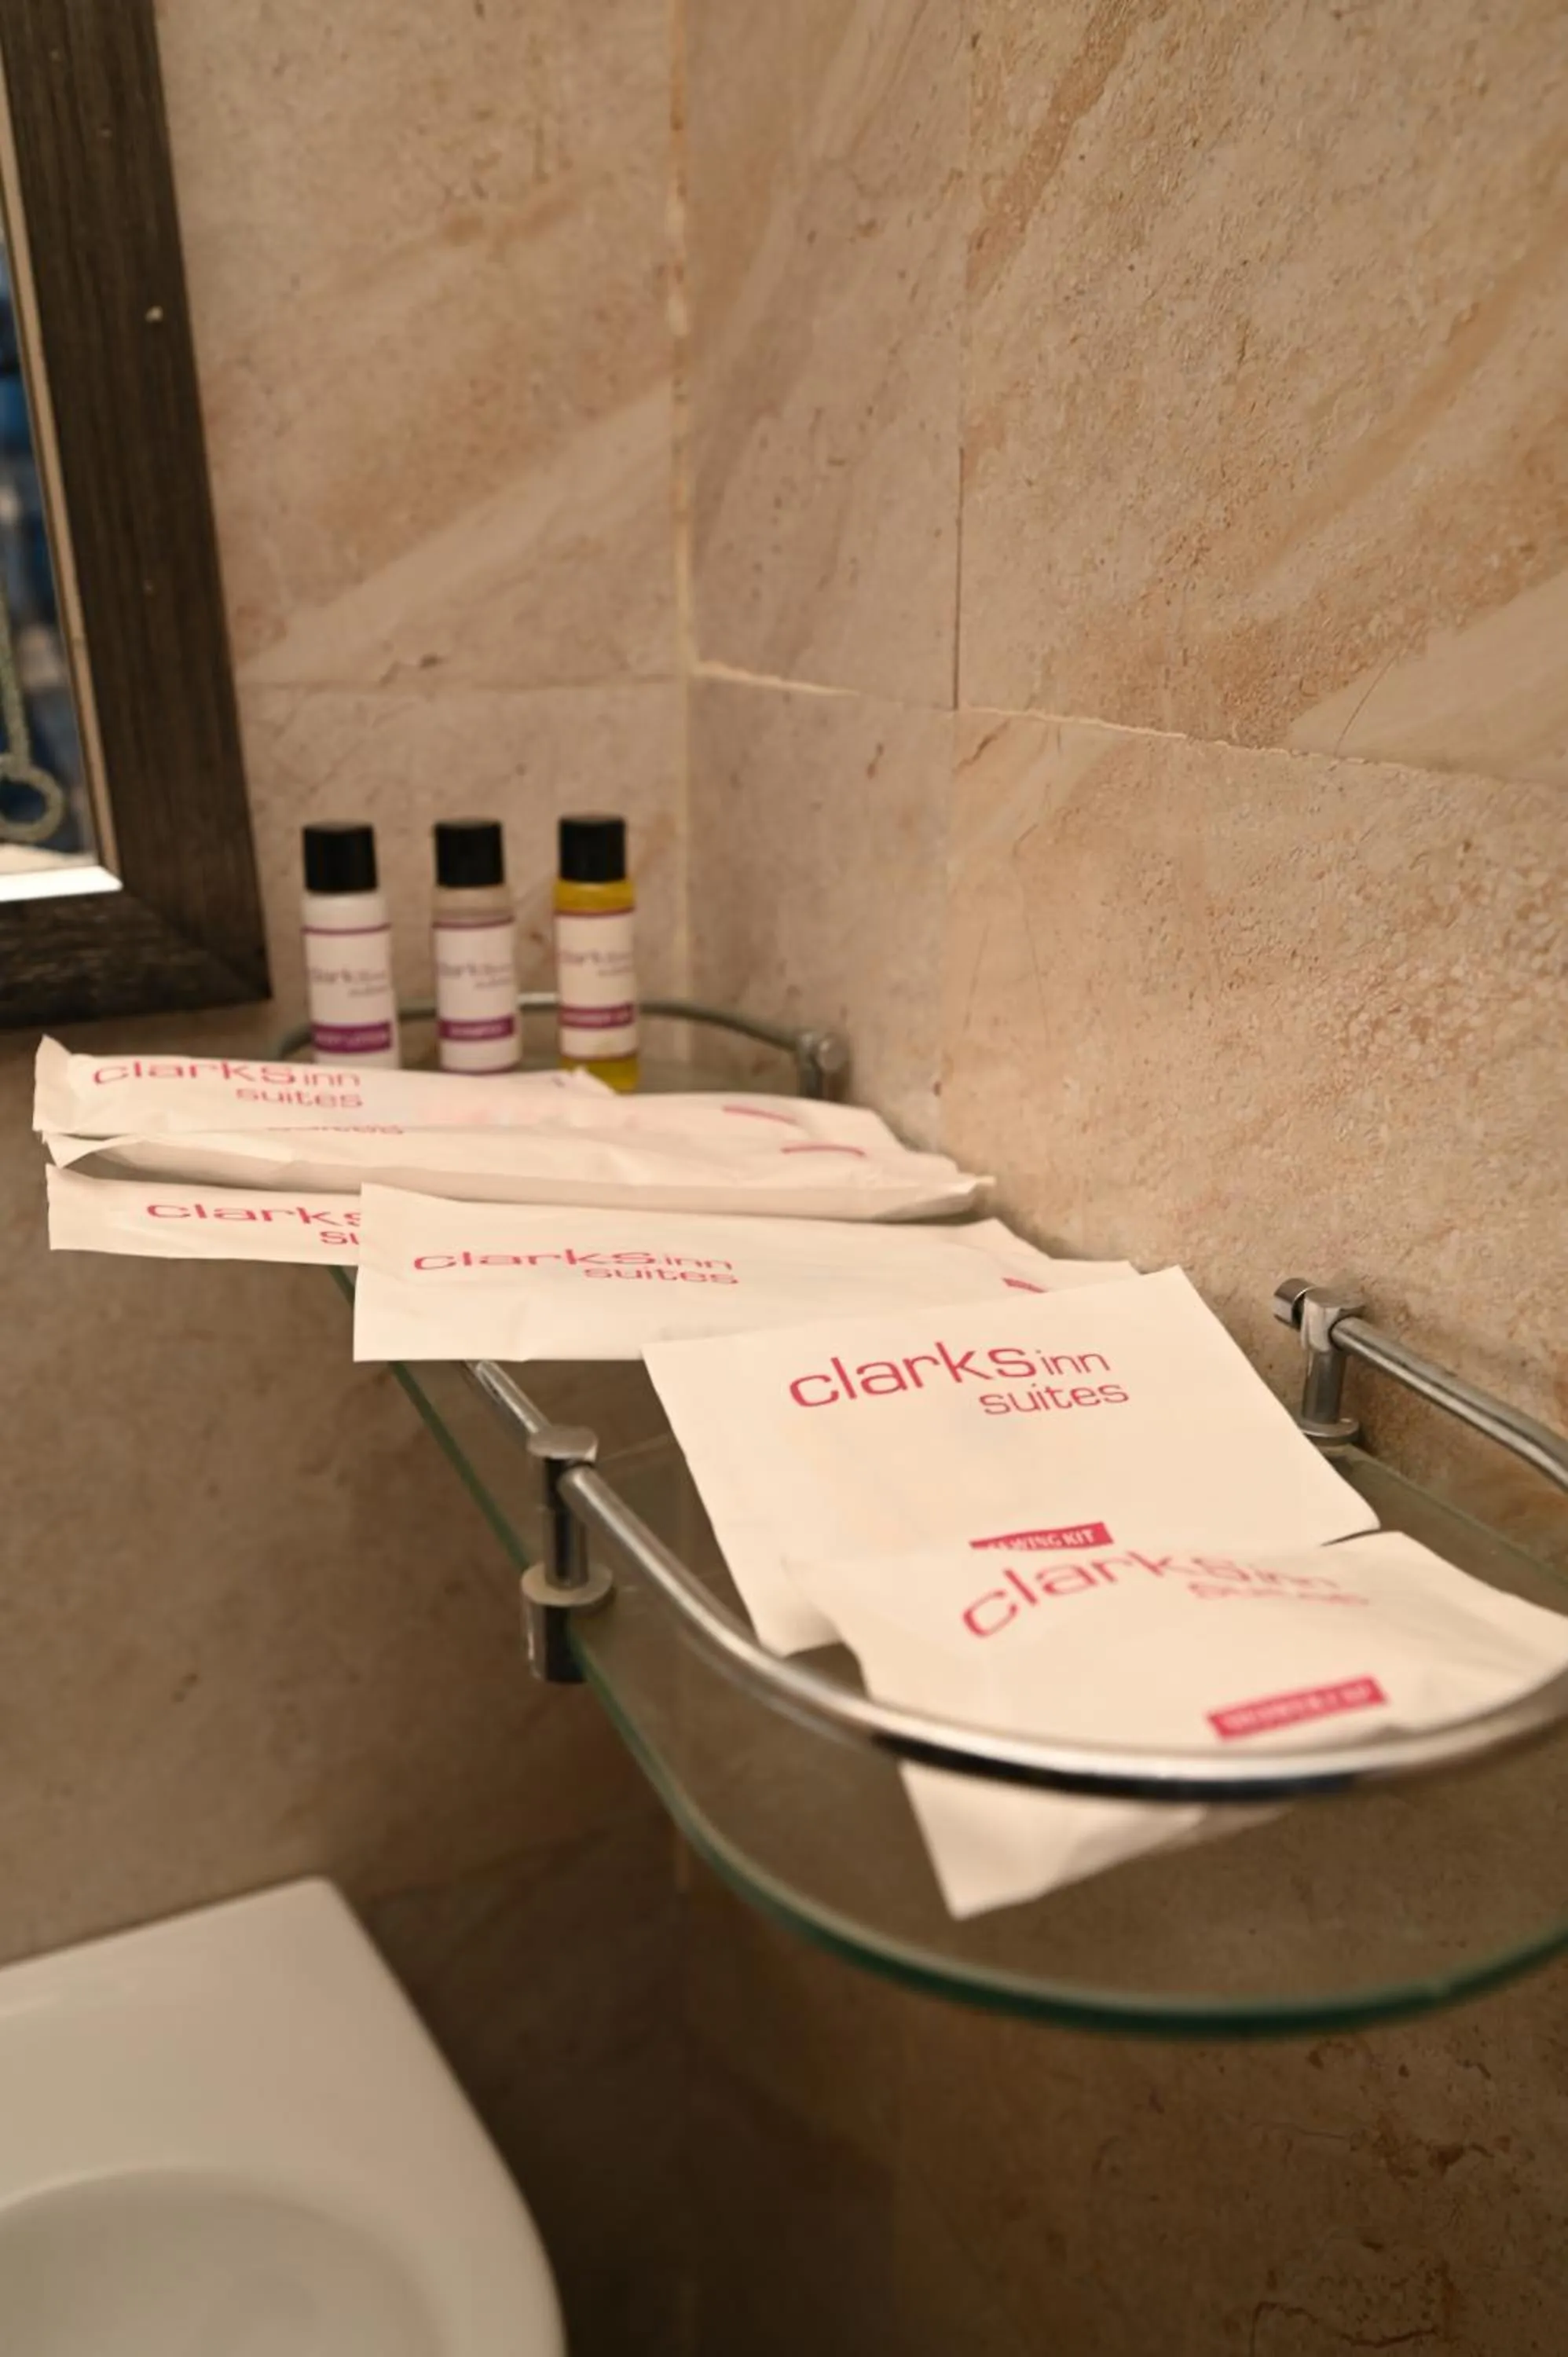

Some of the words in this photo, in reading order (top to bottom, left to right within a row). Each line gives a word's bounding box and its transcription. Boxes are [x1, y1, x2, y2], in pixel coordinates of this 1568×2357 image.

[236, 1088, 362, 1108] suites
[414, 1248, 655, 1270] clarks
[584, 1266, 738, 1285] suites
[789, 1341, 1037, 1407] clarks
[978, 1383, 1130, 1415] suites
[1062, 1529, 1095, 1546] KIT
